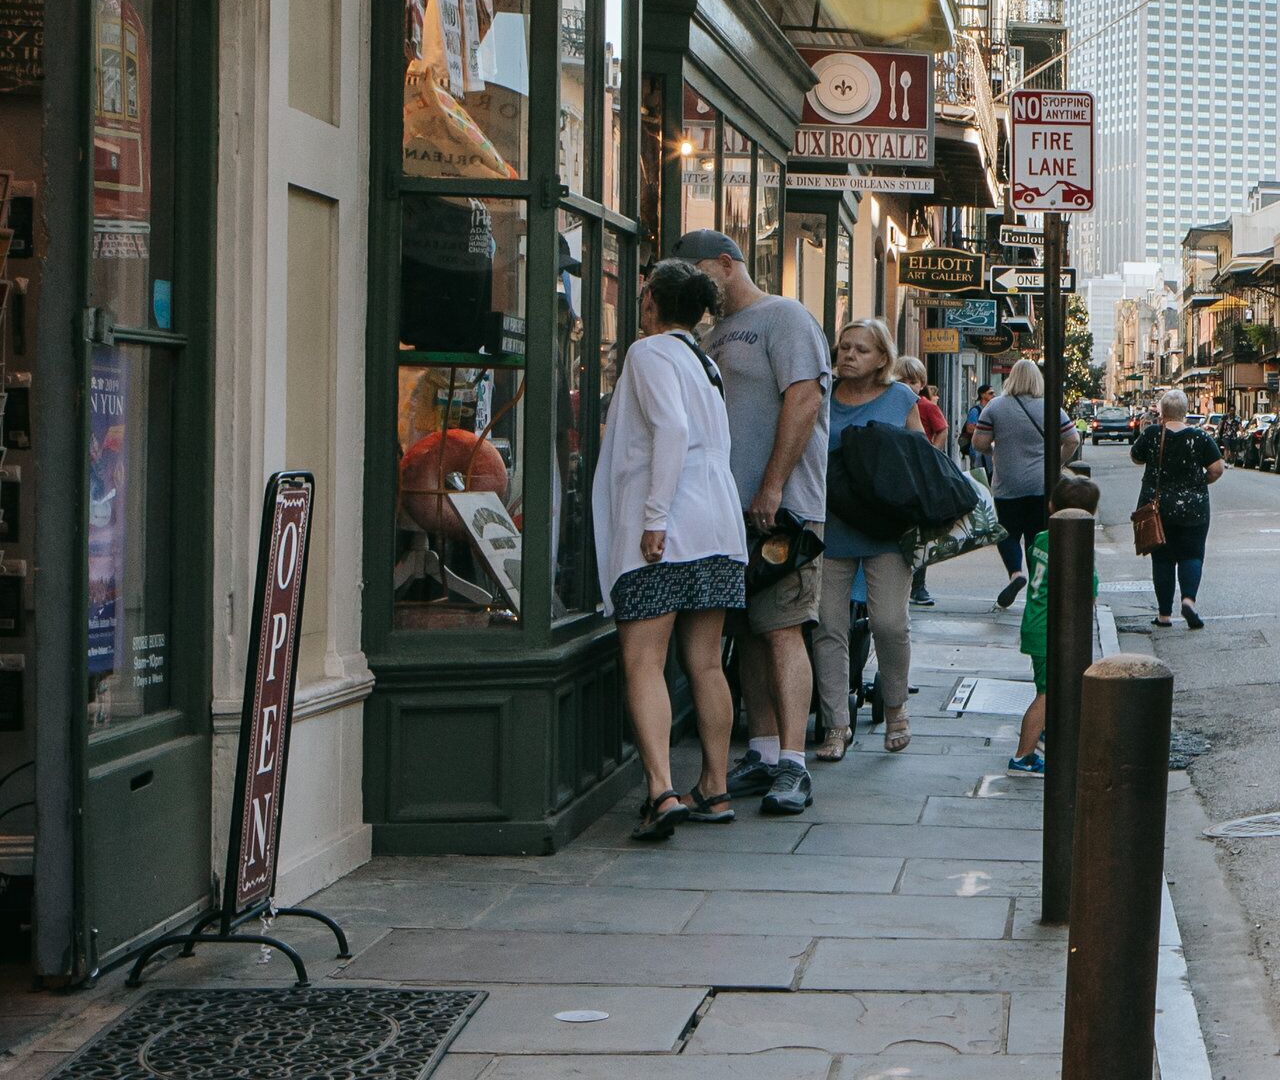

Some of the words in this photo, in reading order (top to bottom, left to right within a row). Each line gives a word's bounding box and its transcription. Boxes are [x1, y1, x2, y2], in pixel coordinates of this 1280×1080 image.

[1014, 96, 1040, 121] NO
[1042, 97, 1090, 108] STOPPING
[1045, 109, 1087, 120] ANYTIME
[831, 132, 927, 159] ROYALE
[1032, 131, 1073, 151] FIRE
[1028, 157, 1077, 177] LANE
[796, 176, 821, 187] DINE
[825, 177, 847, 187] NEW
[850, 178, 896, 190] ORLEANS
[899, 180, 931, 191] STYLE
[1002, 231, 1044, 244] Toulou
[908, 256, 974, 272] ELLIOTT
[907, 271, 927, 280] ART
[931, 272, 974, 282] GALLERY
[1017, 275, 1040, 286] ONE
[100, 393, 124, 416] YUN
[246, 520, 299, 868] OPEN
